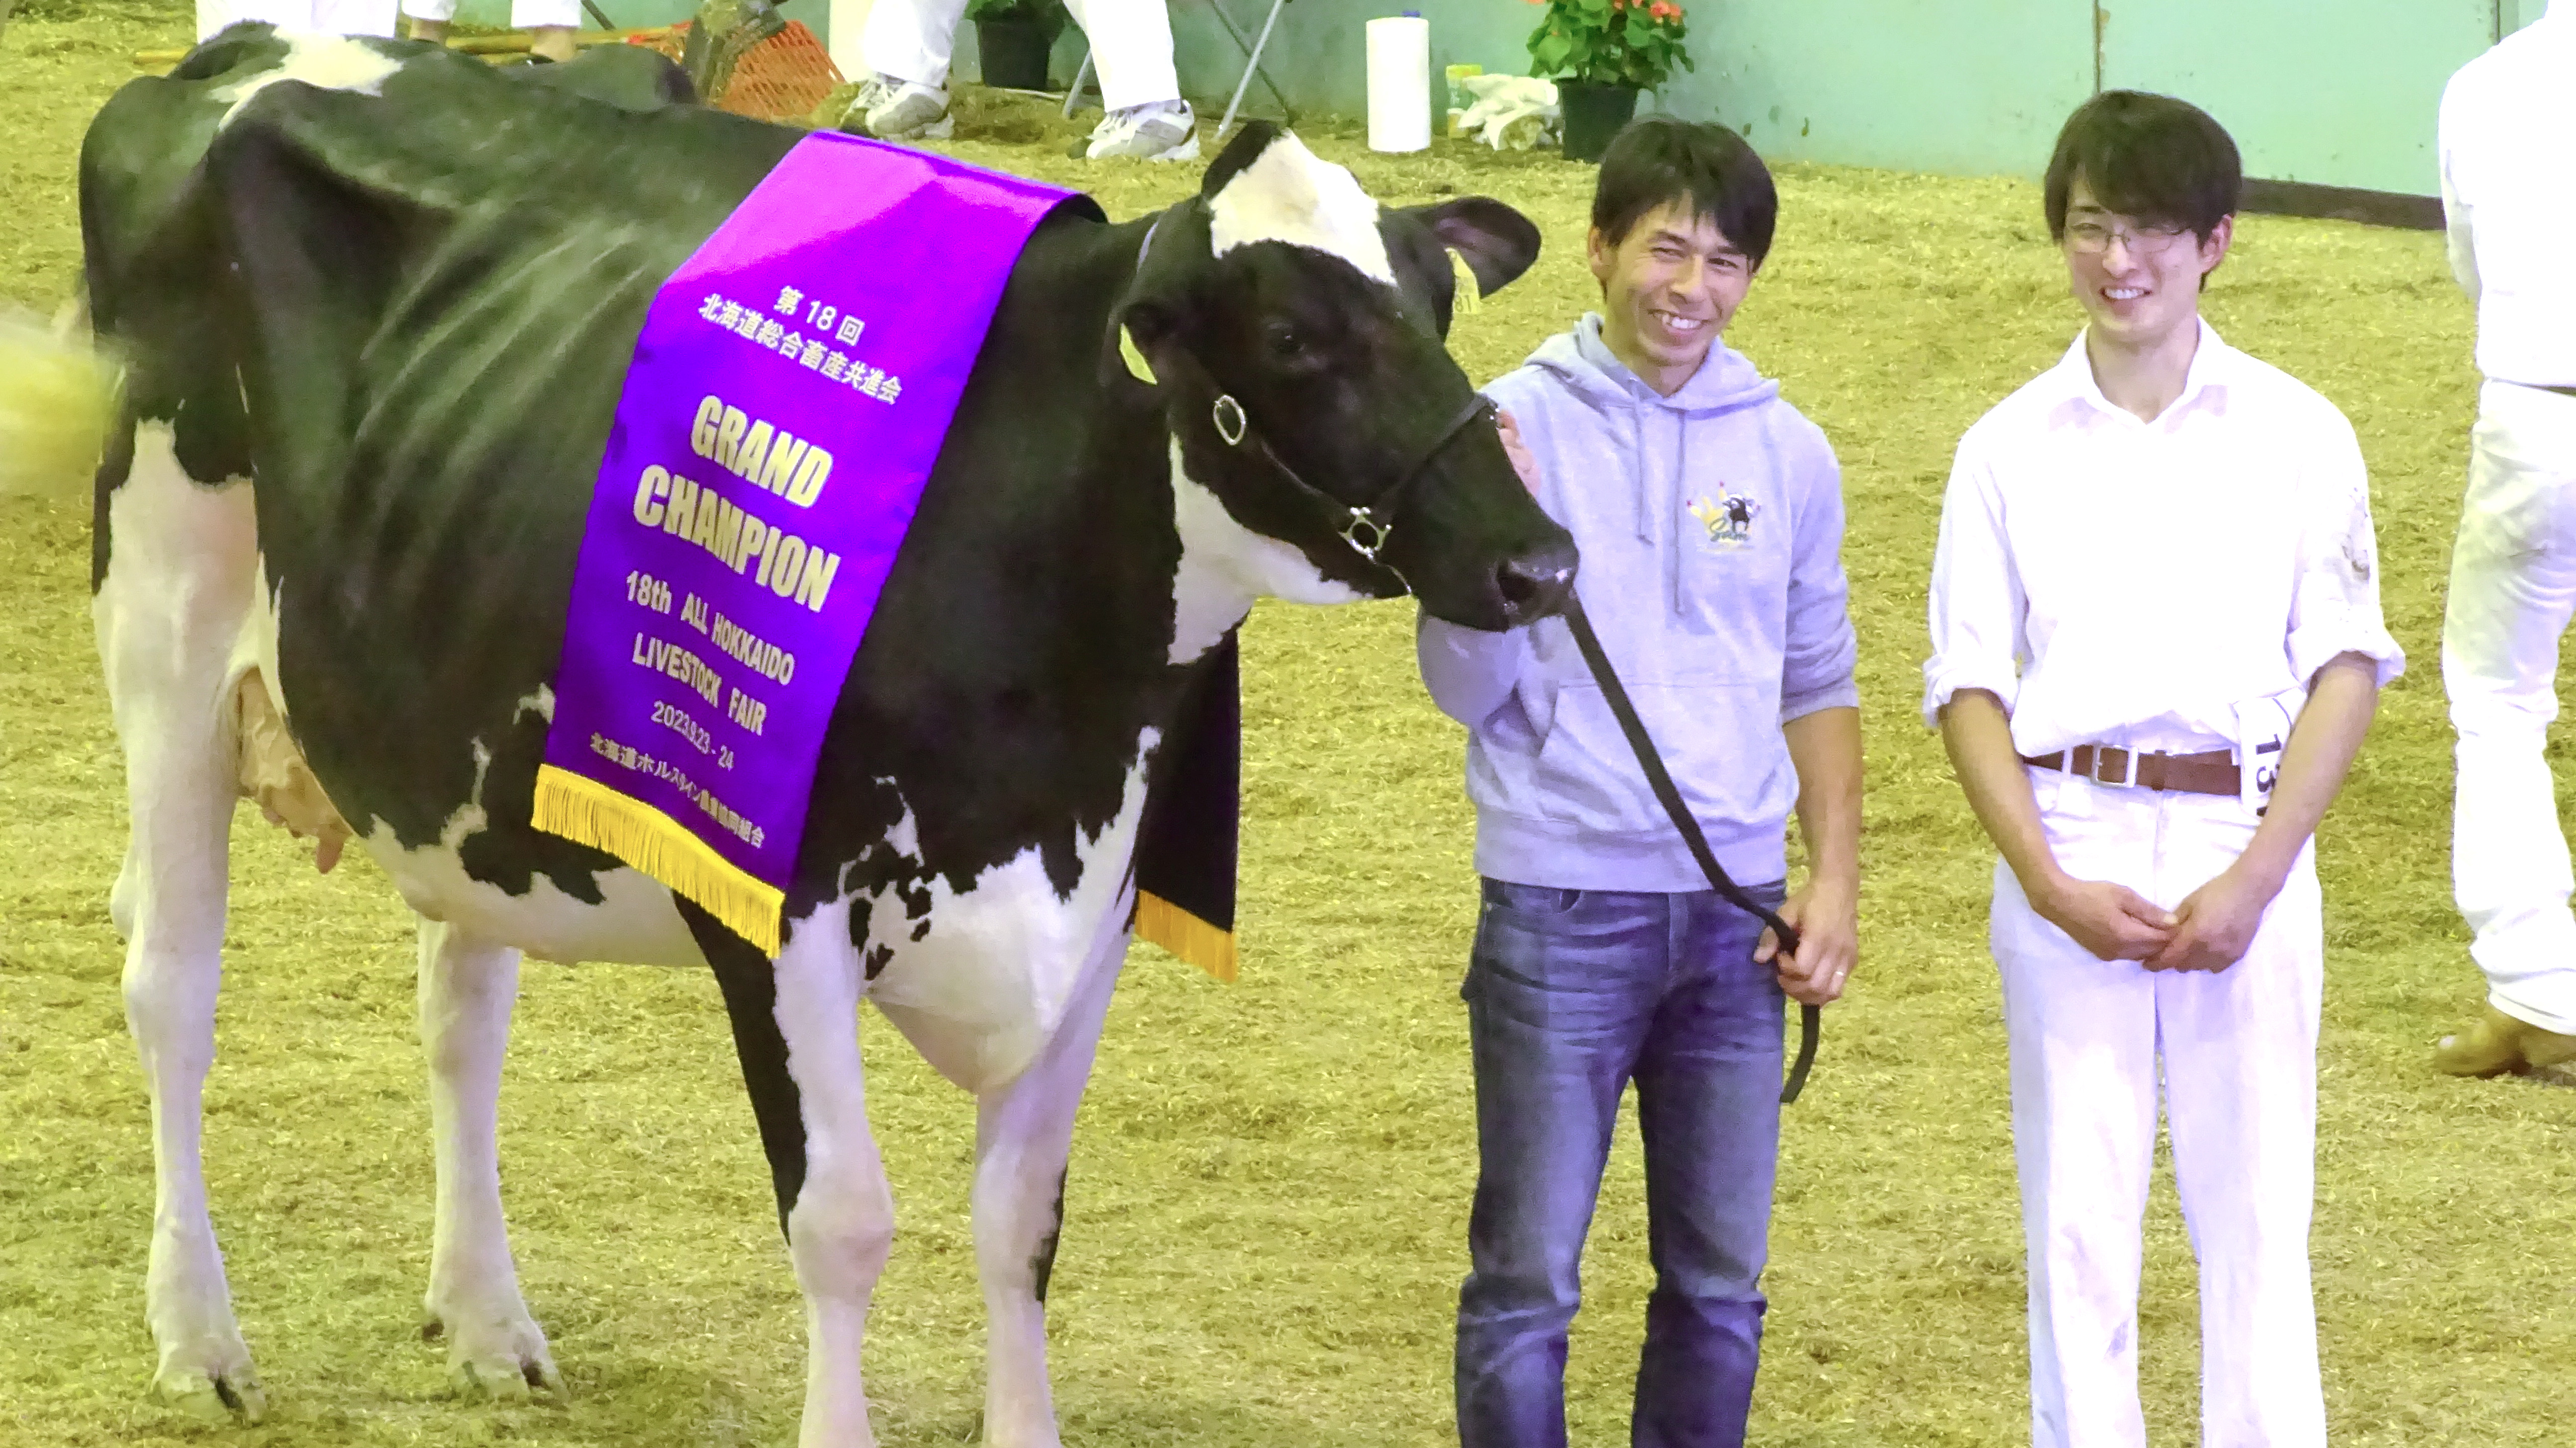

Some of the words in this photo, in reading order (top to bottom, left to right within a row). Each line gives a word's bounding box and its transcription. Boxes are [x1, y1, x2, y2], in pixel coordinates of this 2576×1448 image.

[698, 295, 902, 405] 北海道総合畜産共進会
[691, 396, 833, 509] GRAND
[633, 465, 841, 613] CHAMPION
[627, 570, 672, 614] 18th
[681, 592, 708, 635] ALL
[712, 612, 795, 684] HOKKAIDO
[633, 633, 722, 708] LIVESTOCK
[728, 688, 767, 735] FAIR
